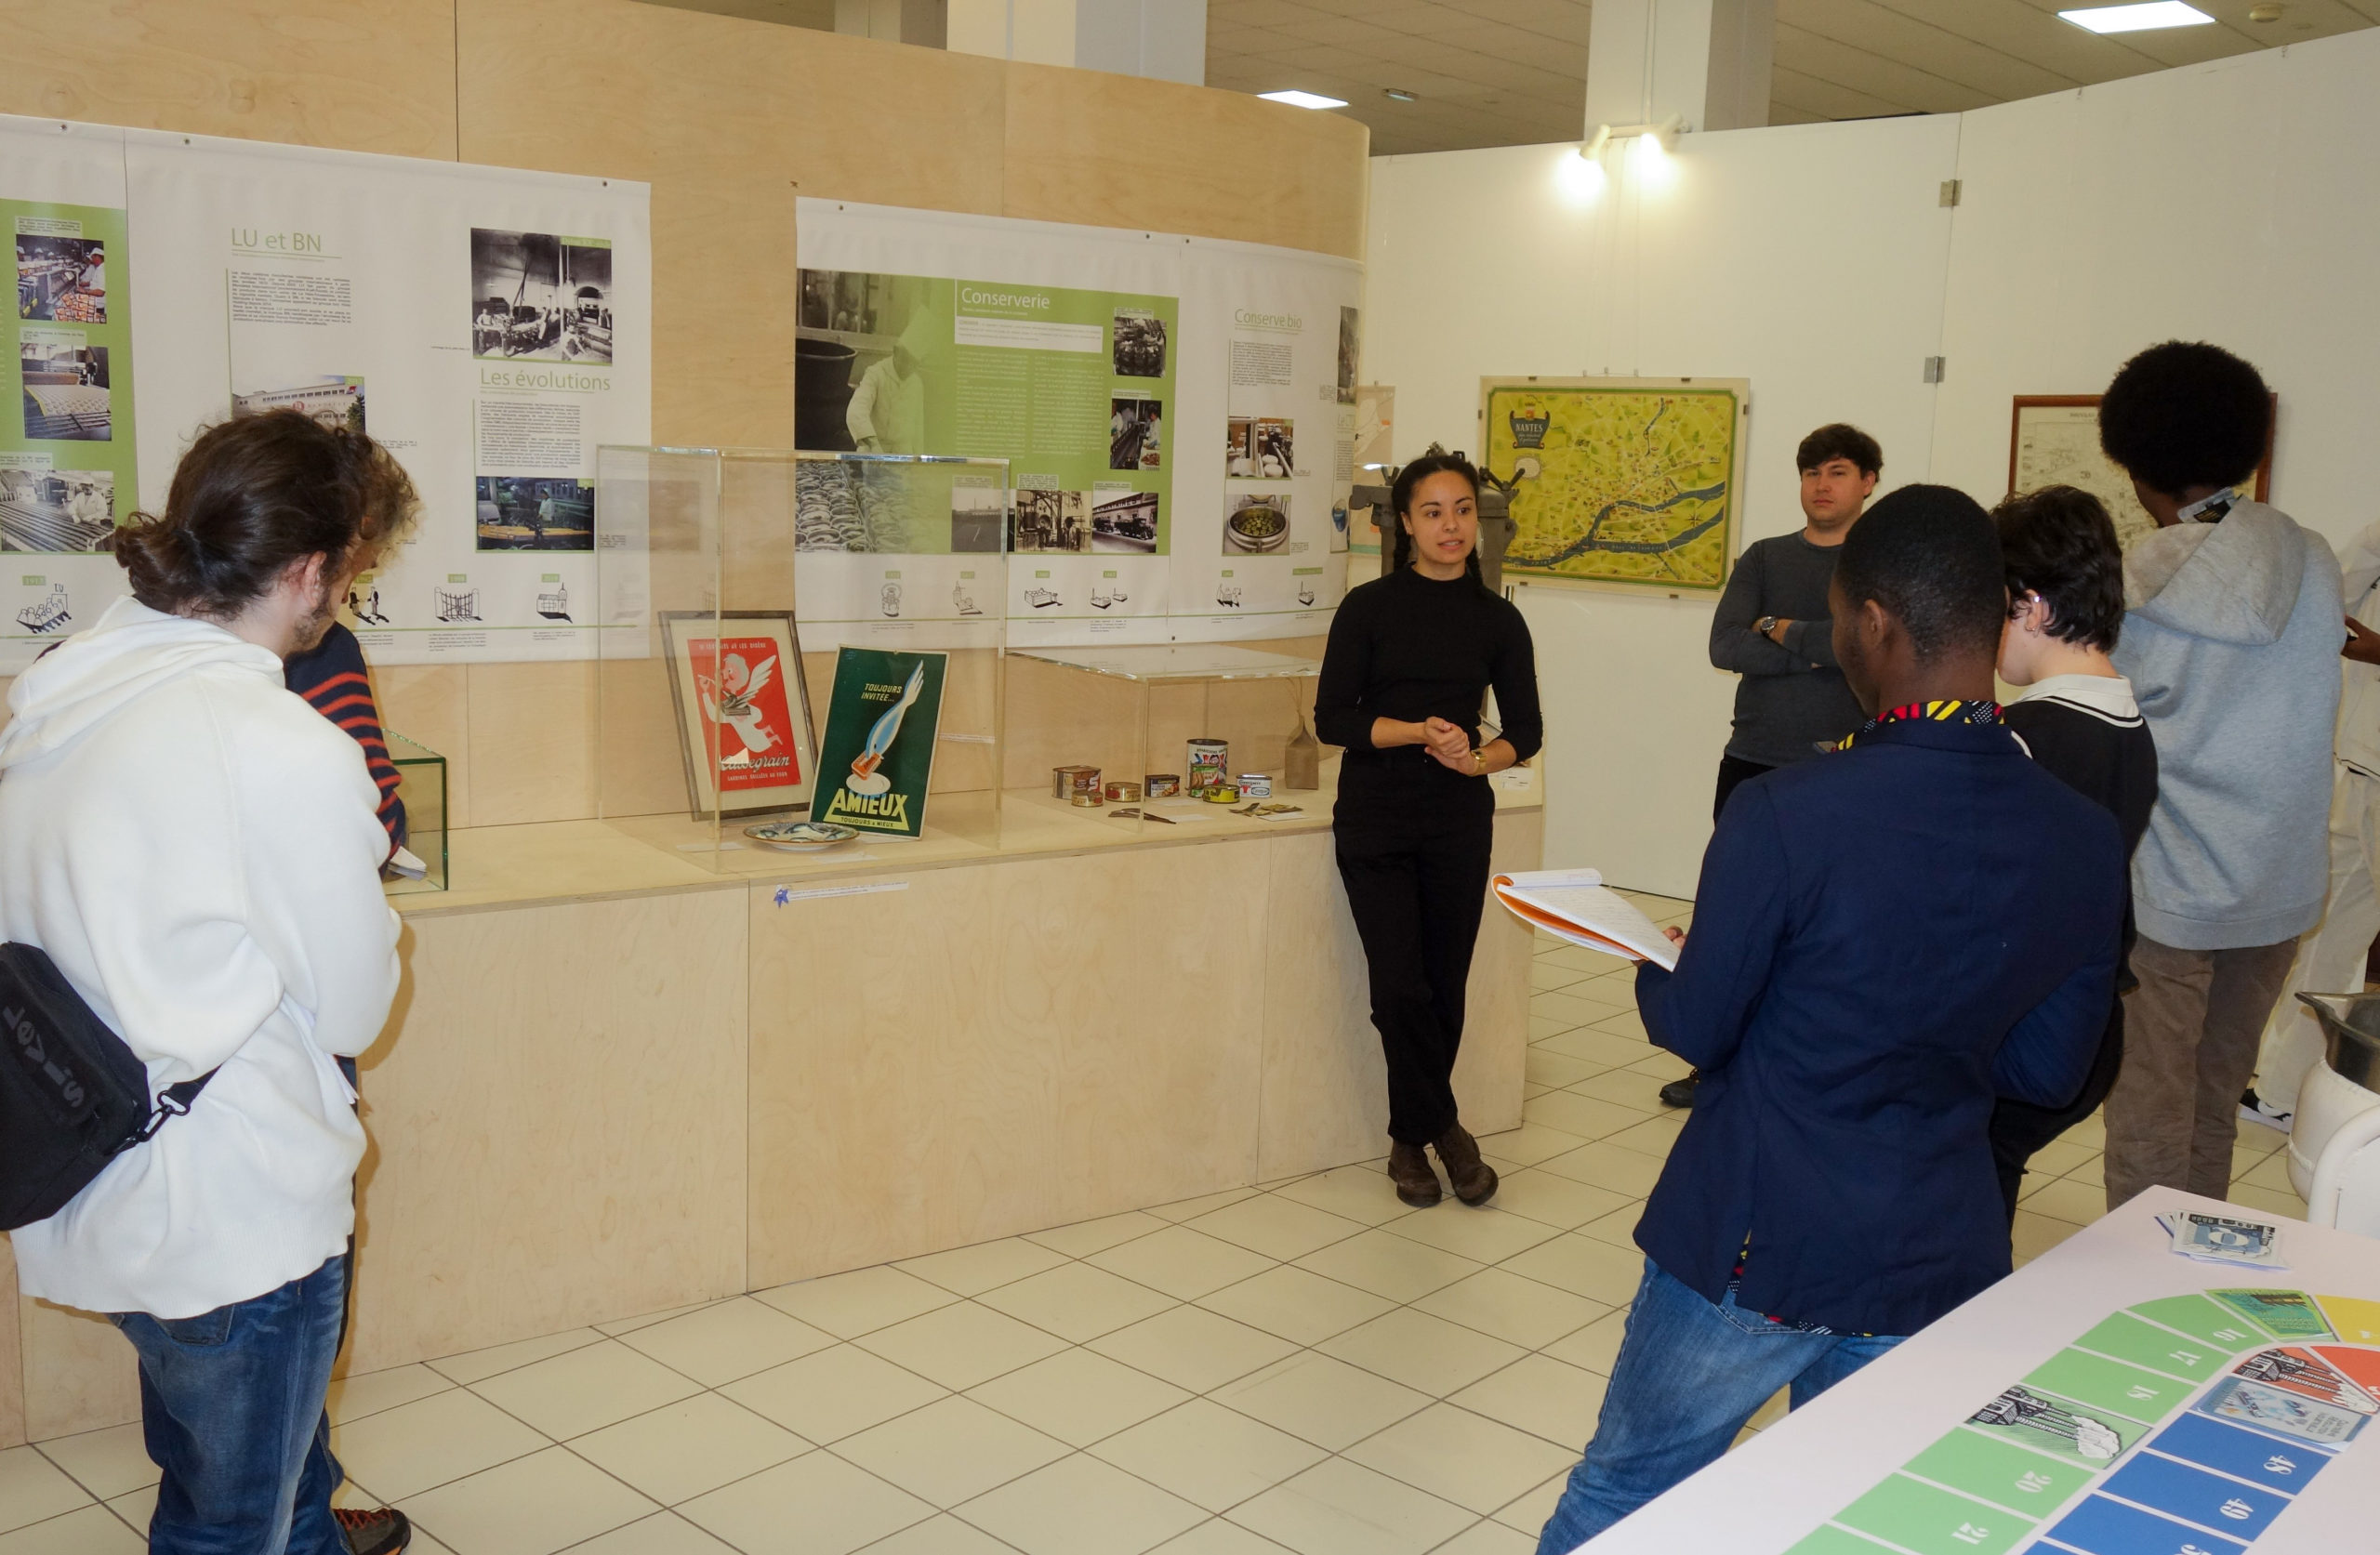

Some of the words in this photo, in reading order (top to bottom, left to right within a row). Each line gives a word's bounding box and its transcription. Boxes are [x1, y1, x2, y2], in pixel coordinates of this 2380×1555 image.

[231, 228, 258, 247] LU
[266, 233, 286, 250] et
[293, 232, 322, 253] BN
[961, 287, 1051, 310] Conserverie
[1235, 309, 1286, 326] Conserve
[1287, 313, 1302, 328] bio
[481, 367, 510, 386] Les
[515, 369, 611, 391] évolutions
[1515, 423, 1543, 432] NANTES
[864, 683, 903, 694] TOUJOURS
[830, 787, 908, 817] AMIEUX
[840, 816, 871, 825] TOUJOURS
[2213, 1328, 2248, 1341] 16
[2169, 1350, 2202, 1366] 17
[2126, 1384, 2160, 1401] 18
[2263, 1455, 2296, 1475] 48
[2015, 1469, 2053, 1493] 20
[2219, 1497, 2254, 1520] 49
[1950, 1522, 1990, 1545] 21
